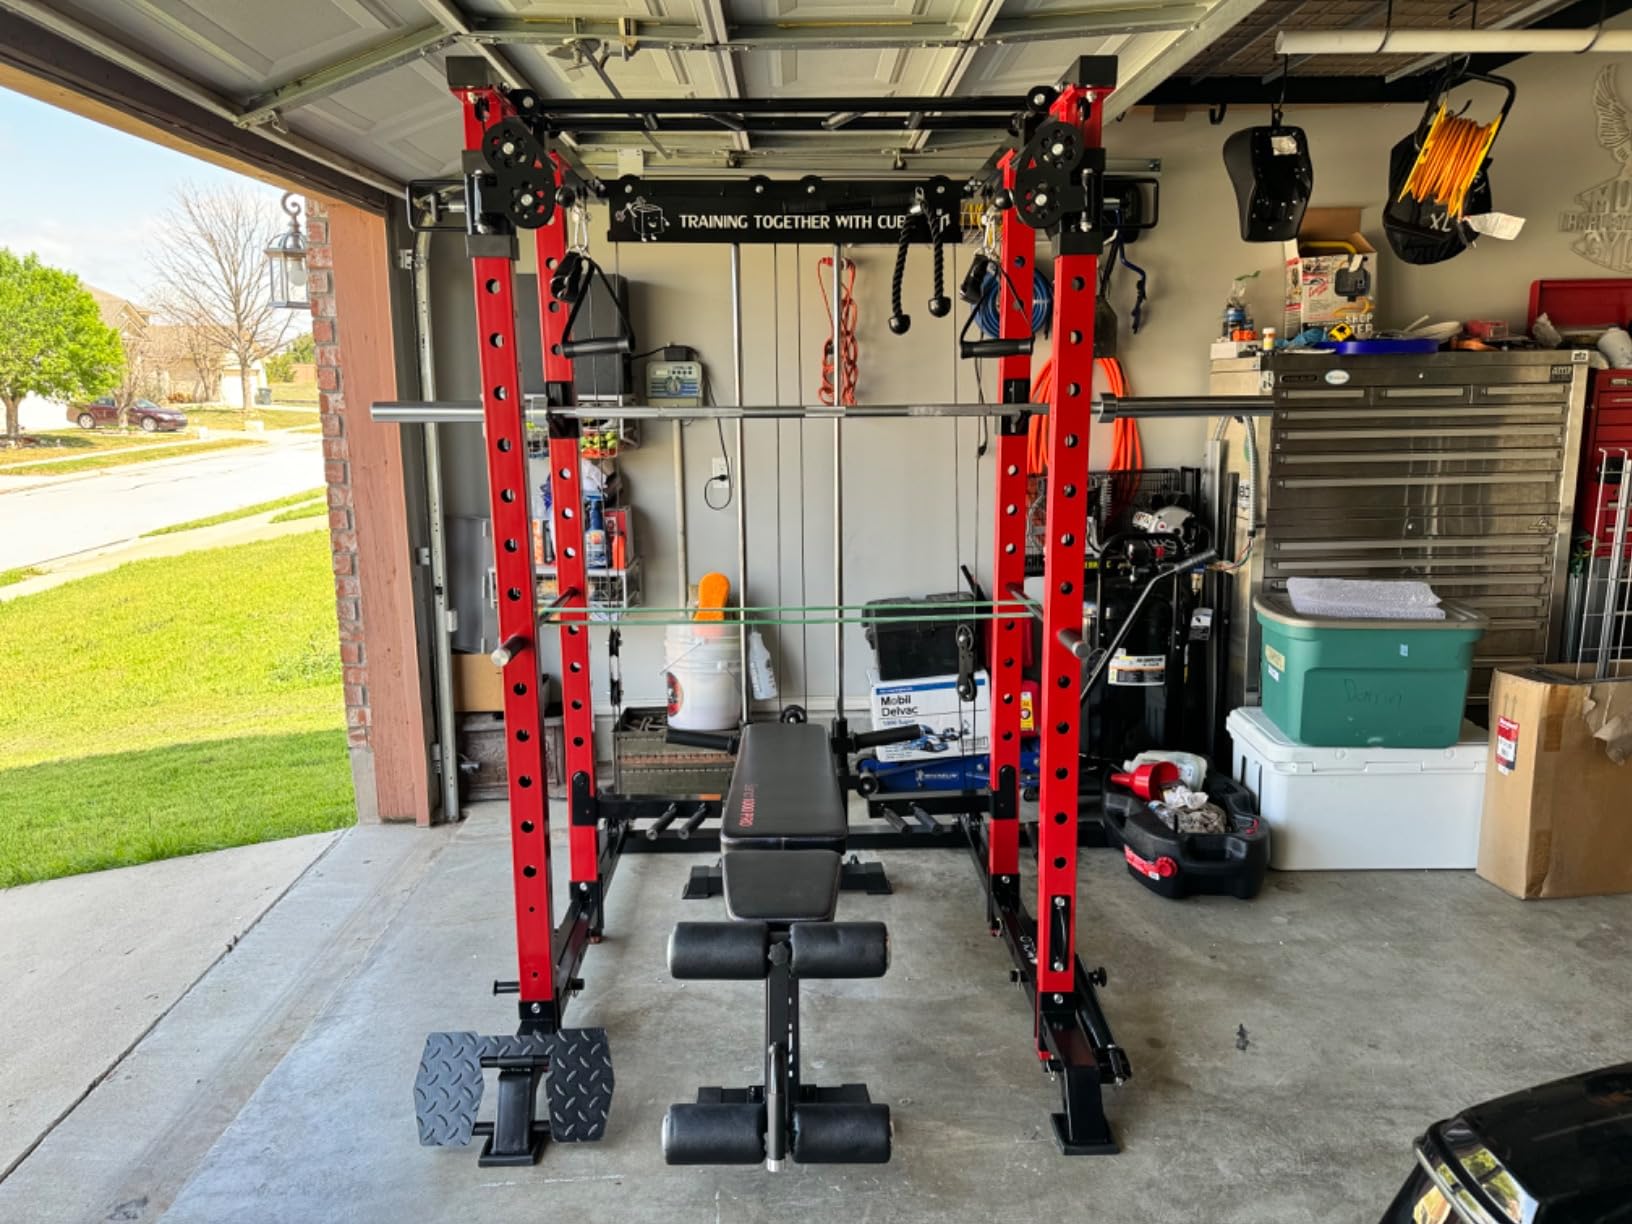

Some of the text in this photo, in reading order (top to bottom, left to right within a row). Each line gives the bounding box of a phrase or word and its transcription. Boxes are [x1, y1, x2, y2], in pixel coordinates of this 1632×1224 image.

[679, 214, 748, 229] TRAINING
[754, 214, 830, 229] TOGETHER
[835, 214, 873, 229] WITH
[1430, 211, 1452, 233] XL
[880, 694, 911, 707] Mobil
[881, 705, 919, 718] Delvac
